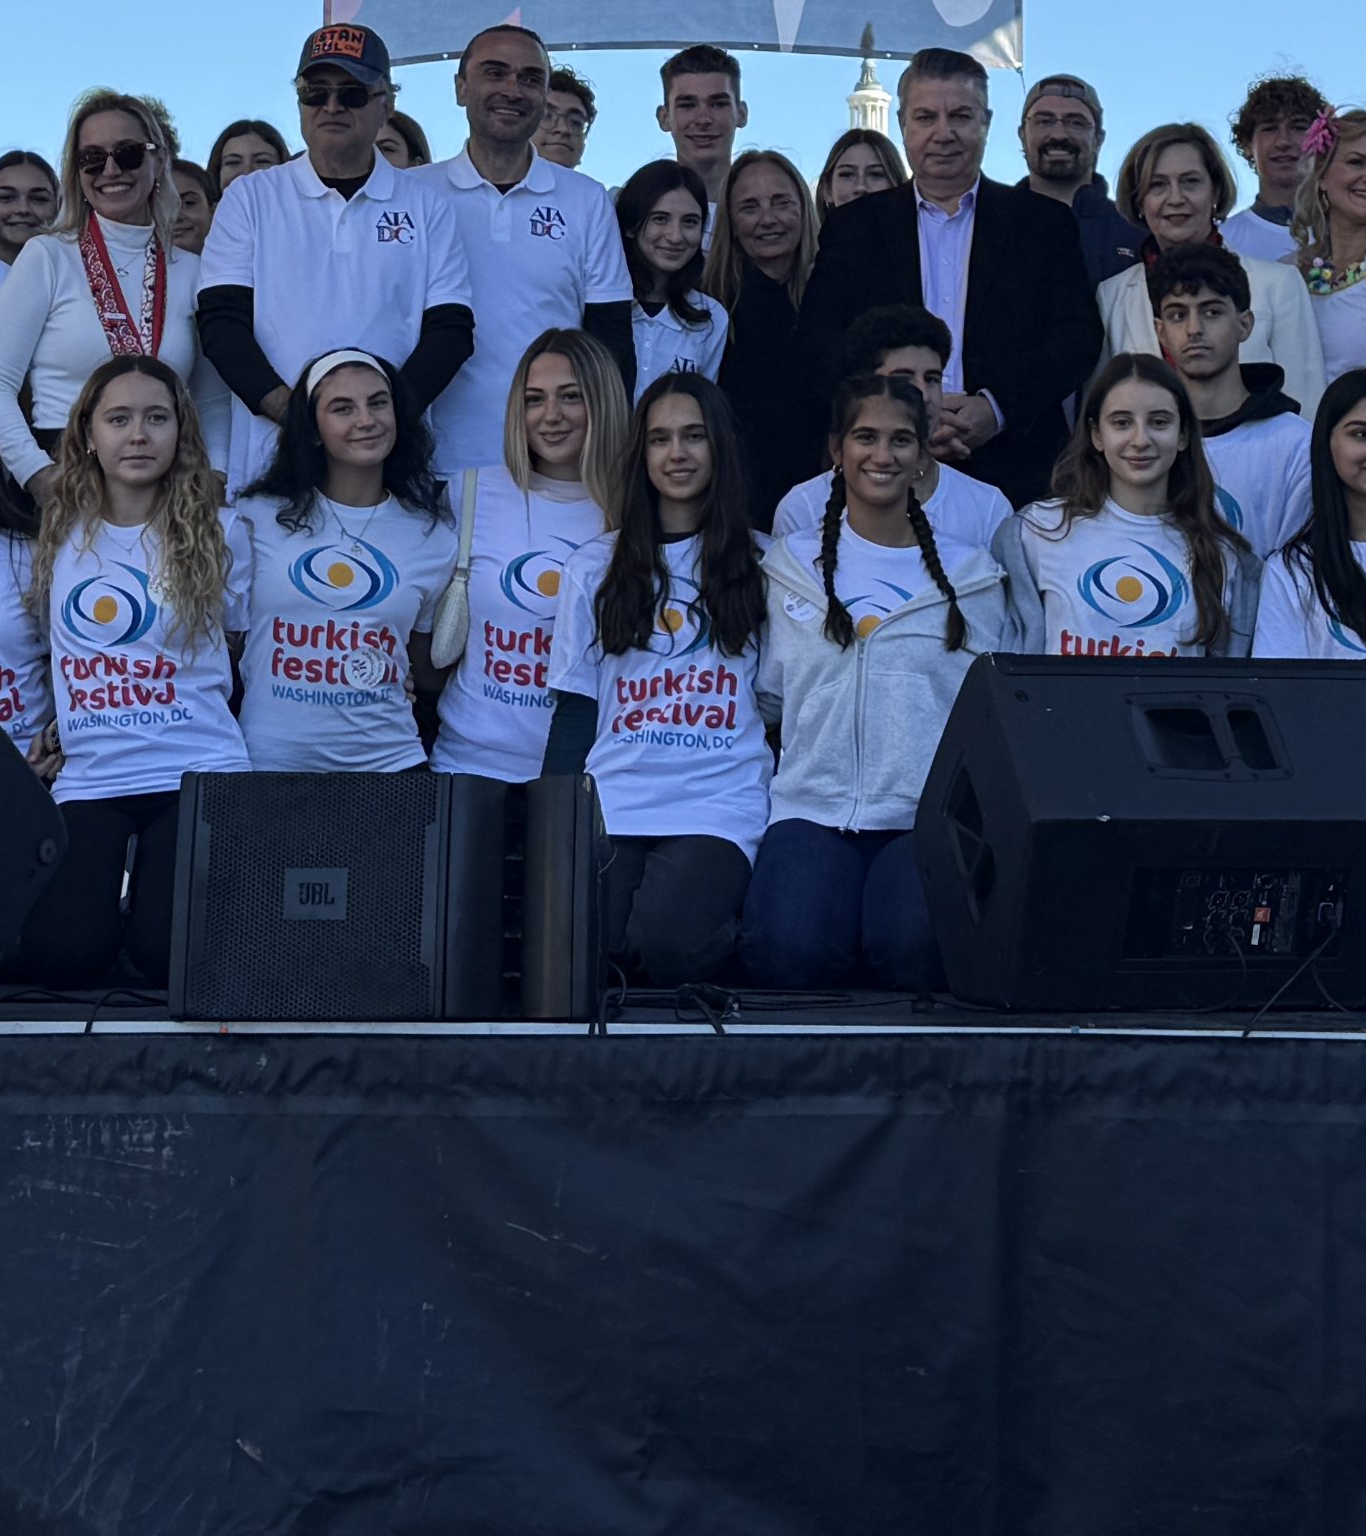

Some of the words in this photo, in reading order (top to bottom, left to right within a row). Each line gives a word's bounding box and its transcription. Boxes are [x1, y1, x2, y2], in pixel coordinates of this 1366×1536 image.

[315, 29, 364, 44] ISTAN
[272, 616, 397, 656] turkish
[484, 620, 554, 656] turk
[1060, 628, 1178, 658] turki
[484, 650, 549, 689] fest
[616, 664, 738, 704] turkish
[483, 683, 554, 709] WASHING
[298, 882, 336, 906] JBL
